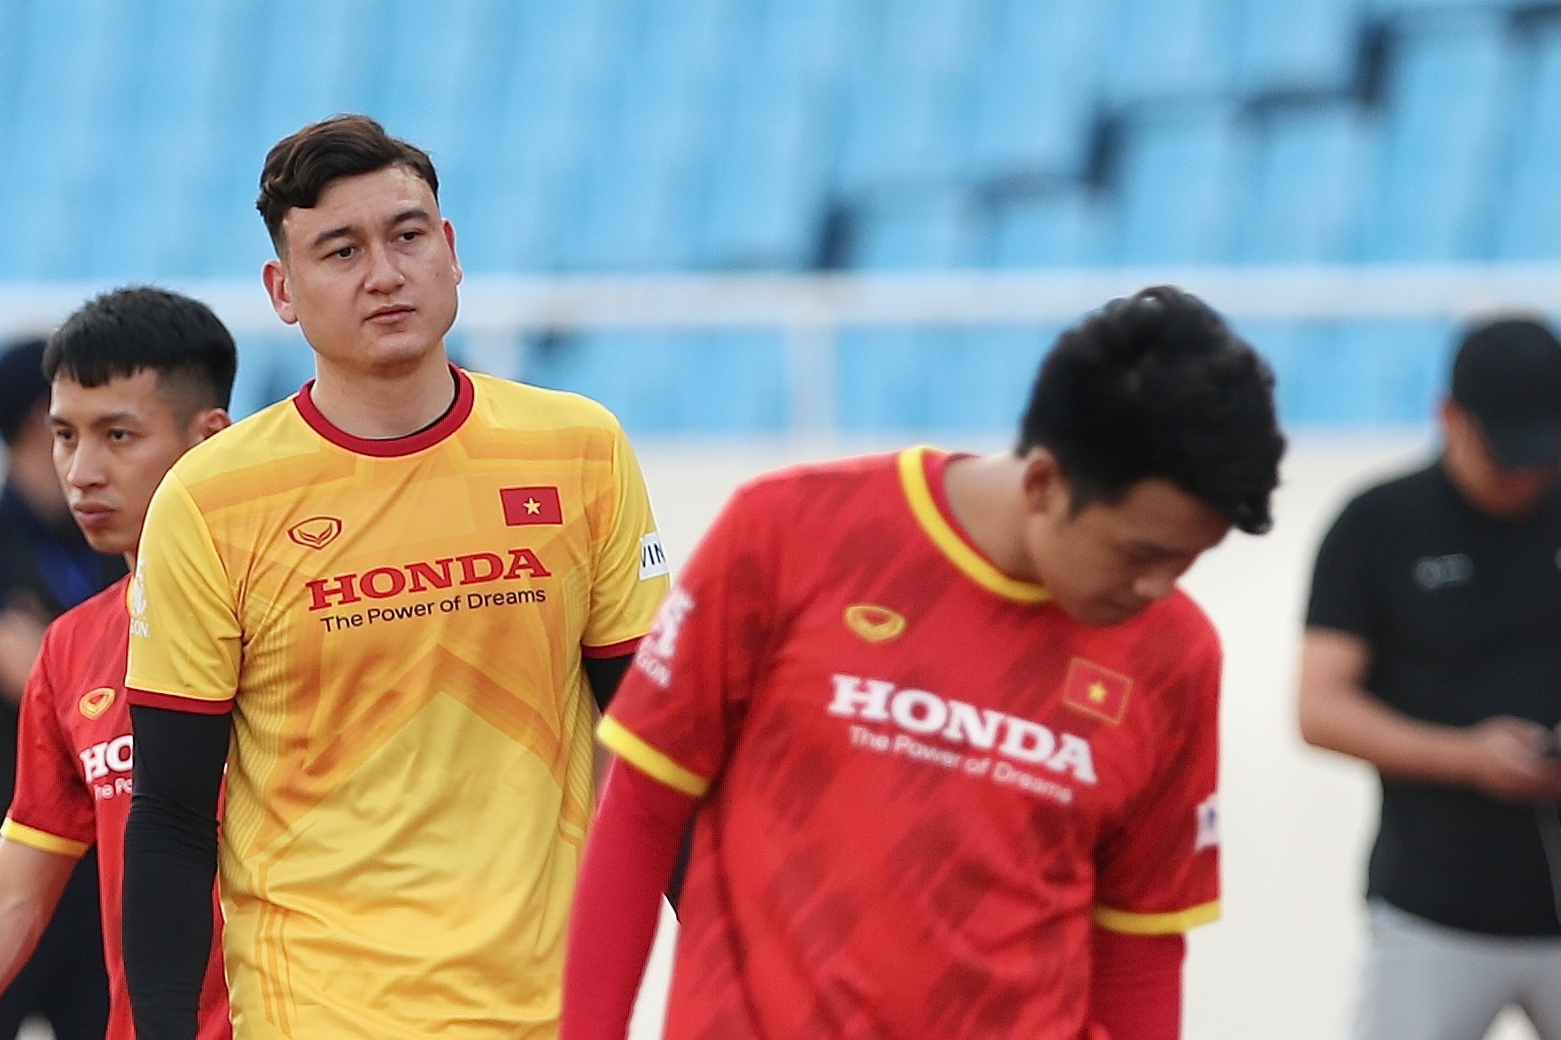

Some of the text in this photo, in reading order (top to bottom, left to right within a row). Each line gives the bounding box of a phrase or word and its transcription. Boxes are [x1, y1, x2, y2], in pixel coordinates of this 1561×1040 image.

[307, 549, 551, 611] HONDA
[321, 589, 545, 633] The Power of Dreams
[828, 674, 1097, 784] HONDA
[849, 725, 1073, 804] The Power of Dreams
